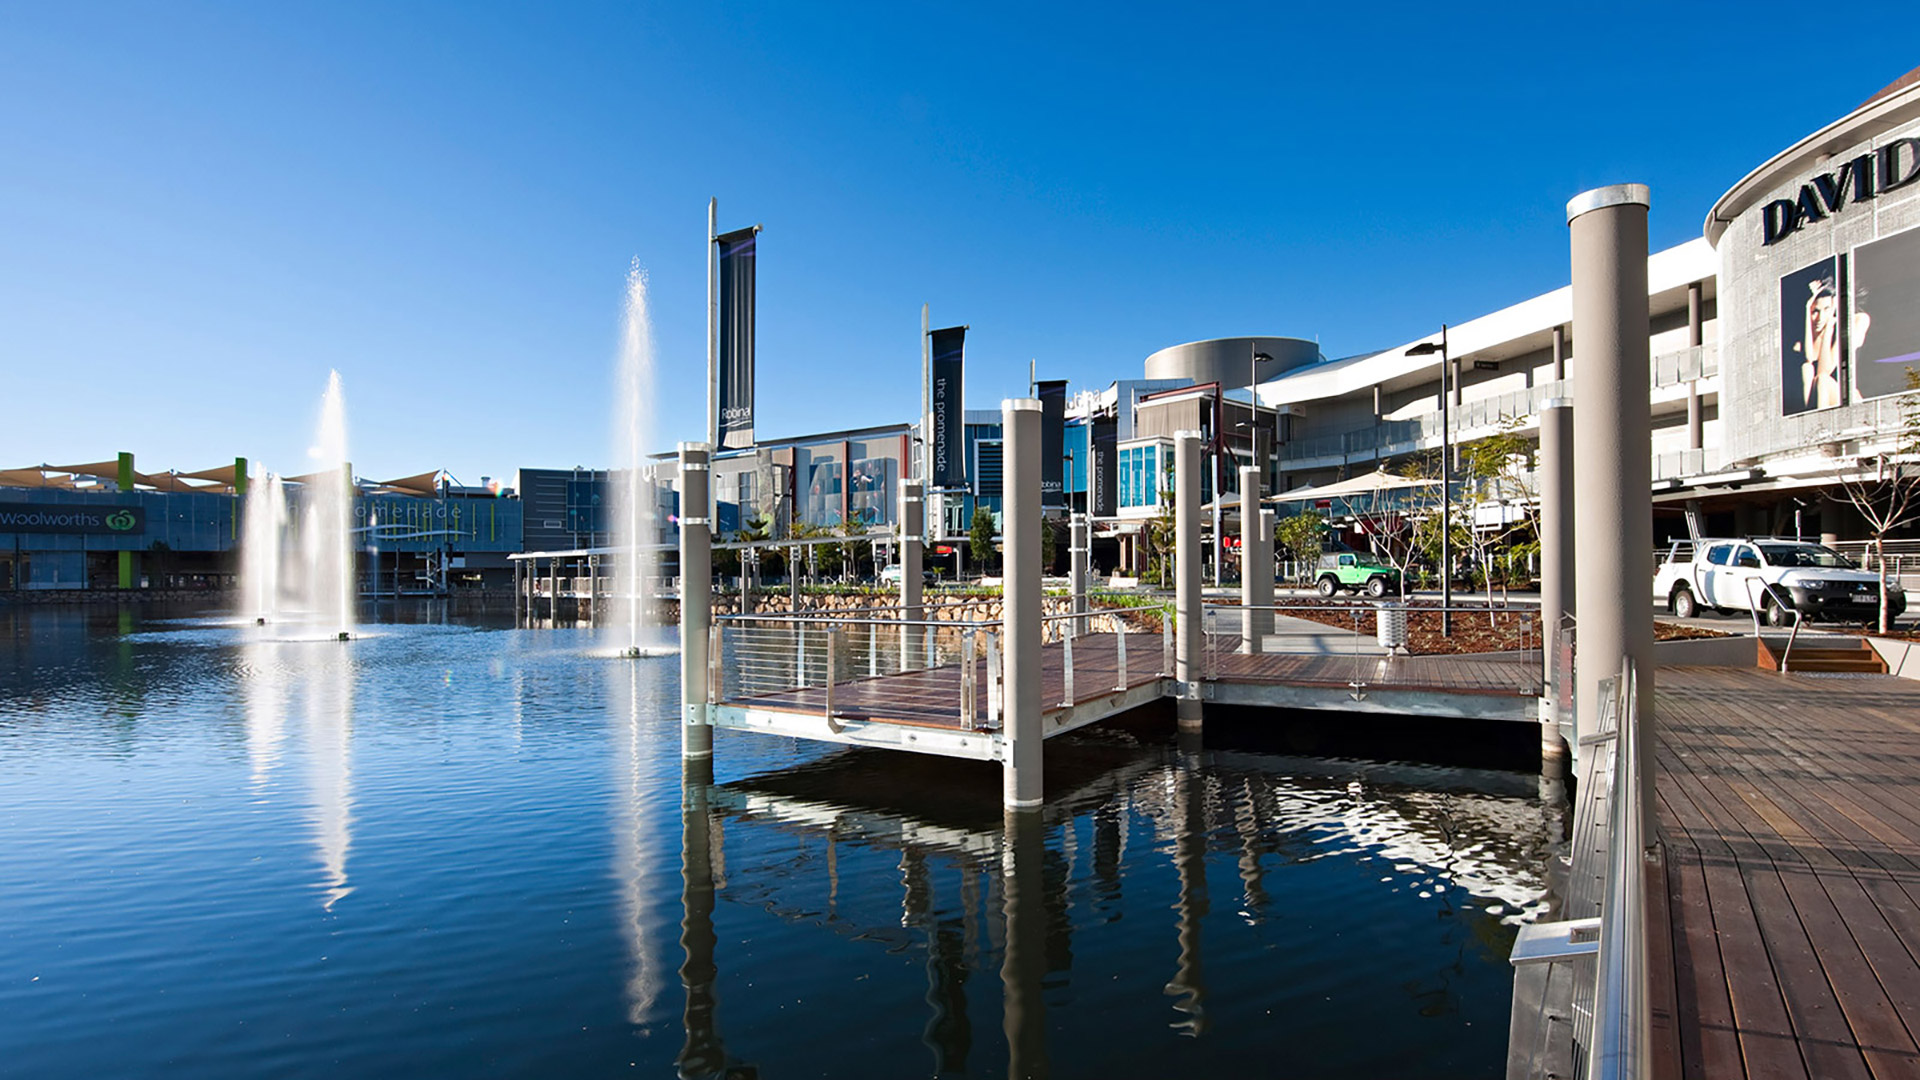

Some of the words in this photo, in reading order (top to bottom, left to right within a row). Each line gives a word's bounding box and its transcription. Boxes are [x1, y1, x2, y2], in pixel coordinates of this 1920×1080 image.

[1761, 137, 1920, 247] DAVID
[936, 378, 947, 399] the
[721, 406, 751, 419] Robina
[935, 401, 947, 472] promenade
[1041, 480, 1062, 489] obina
[1096, 466, 1104, 512] promenade
[355, 502, 462, 520] omenade
